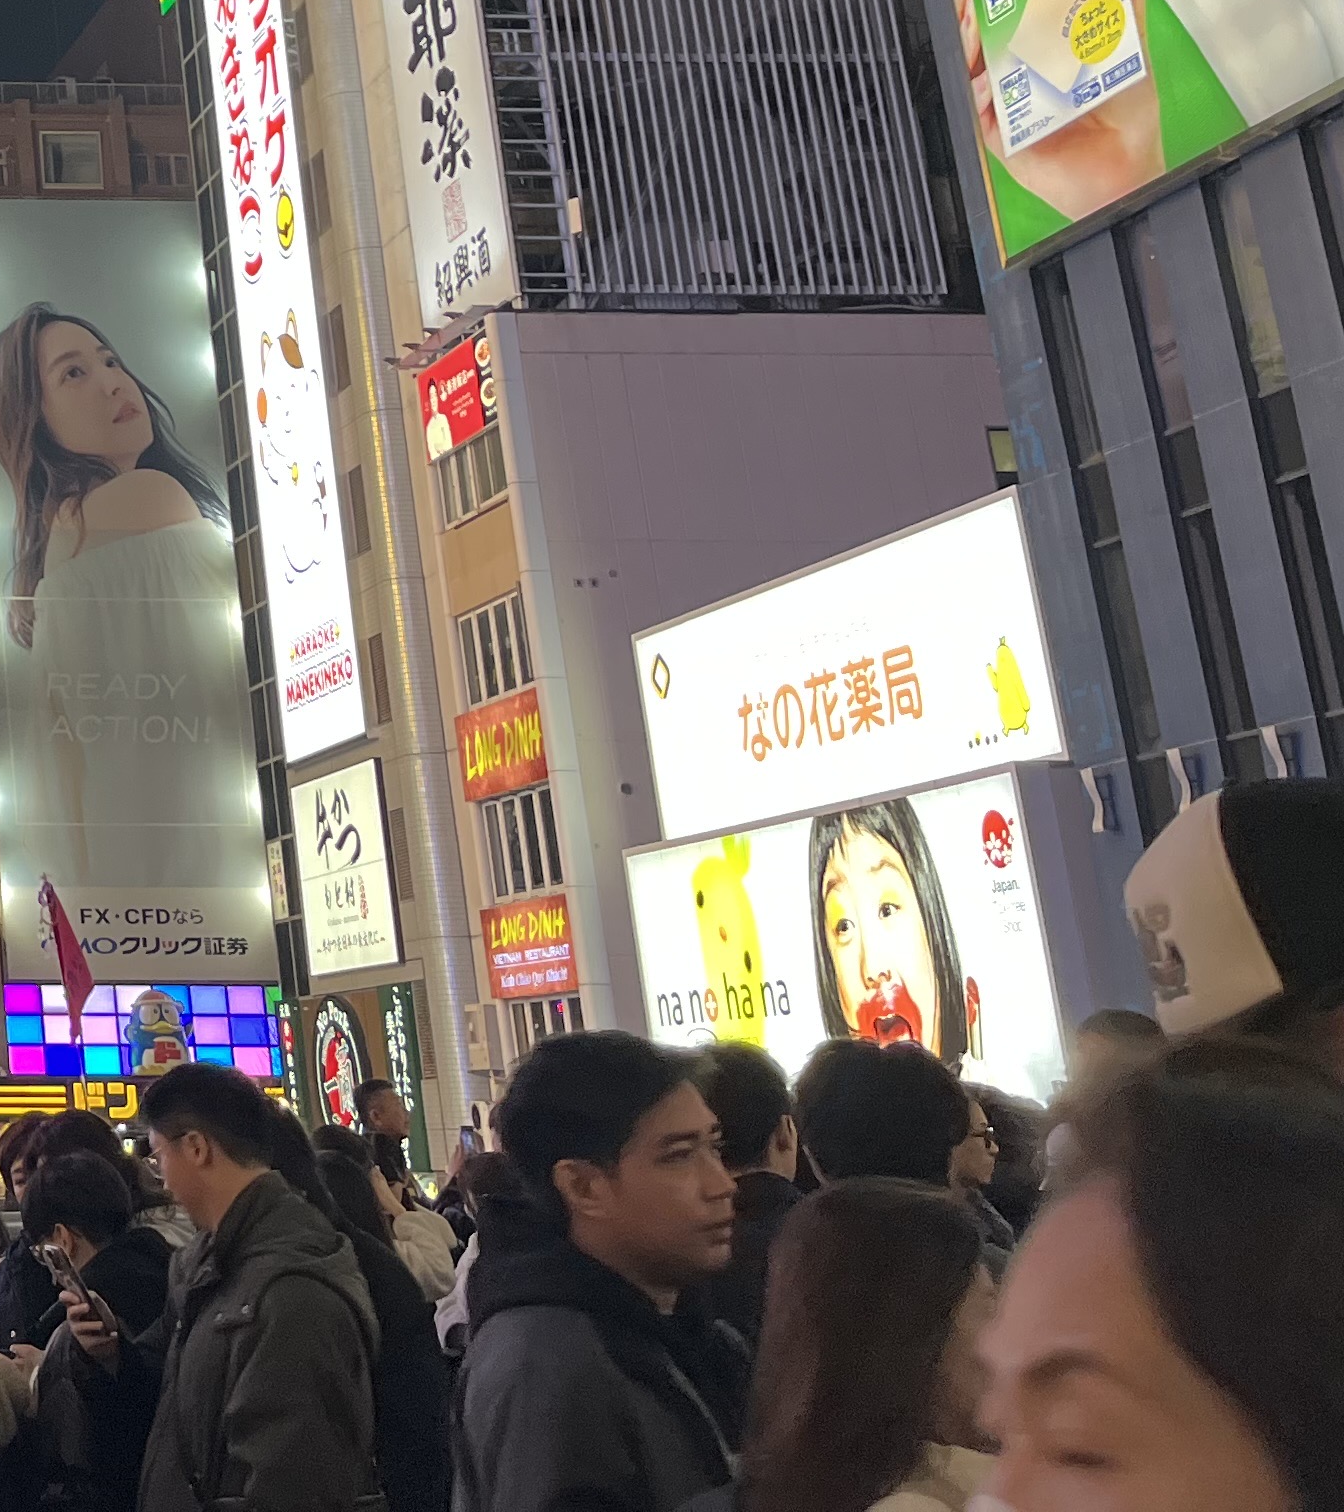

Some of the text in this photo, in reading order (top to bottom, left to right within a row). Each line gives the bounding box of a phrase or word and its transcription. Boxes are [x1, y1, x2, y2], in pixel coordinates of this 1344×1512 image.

[1075, 9, 1122, 50] 大きめサイズ
[1079, 1, 1107, 27] ちょっと
[435, 226, 493, 308] 紹興酒
[293, 623, 335, 659] KARAOKE
[45, 673, 188, 701] READY
[285, 653, 354, 710] MANEKINEKO
[738, 644, 923, 763] なの花薬局
[47, 716, 211, 744] ACTION!
[466, 709, 542, 781] LONG DINH
[316, 788, 361, 870] 牛かつ
[80, 908, 204, 925] FX・CFDなら
[491, 906, 565, 949] LONG DINH
[67, 937, 248, 956] MOクリック証券
[73, 1082, 139, 1120] ドン
